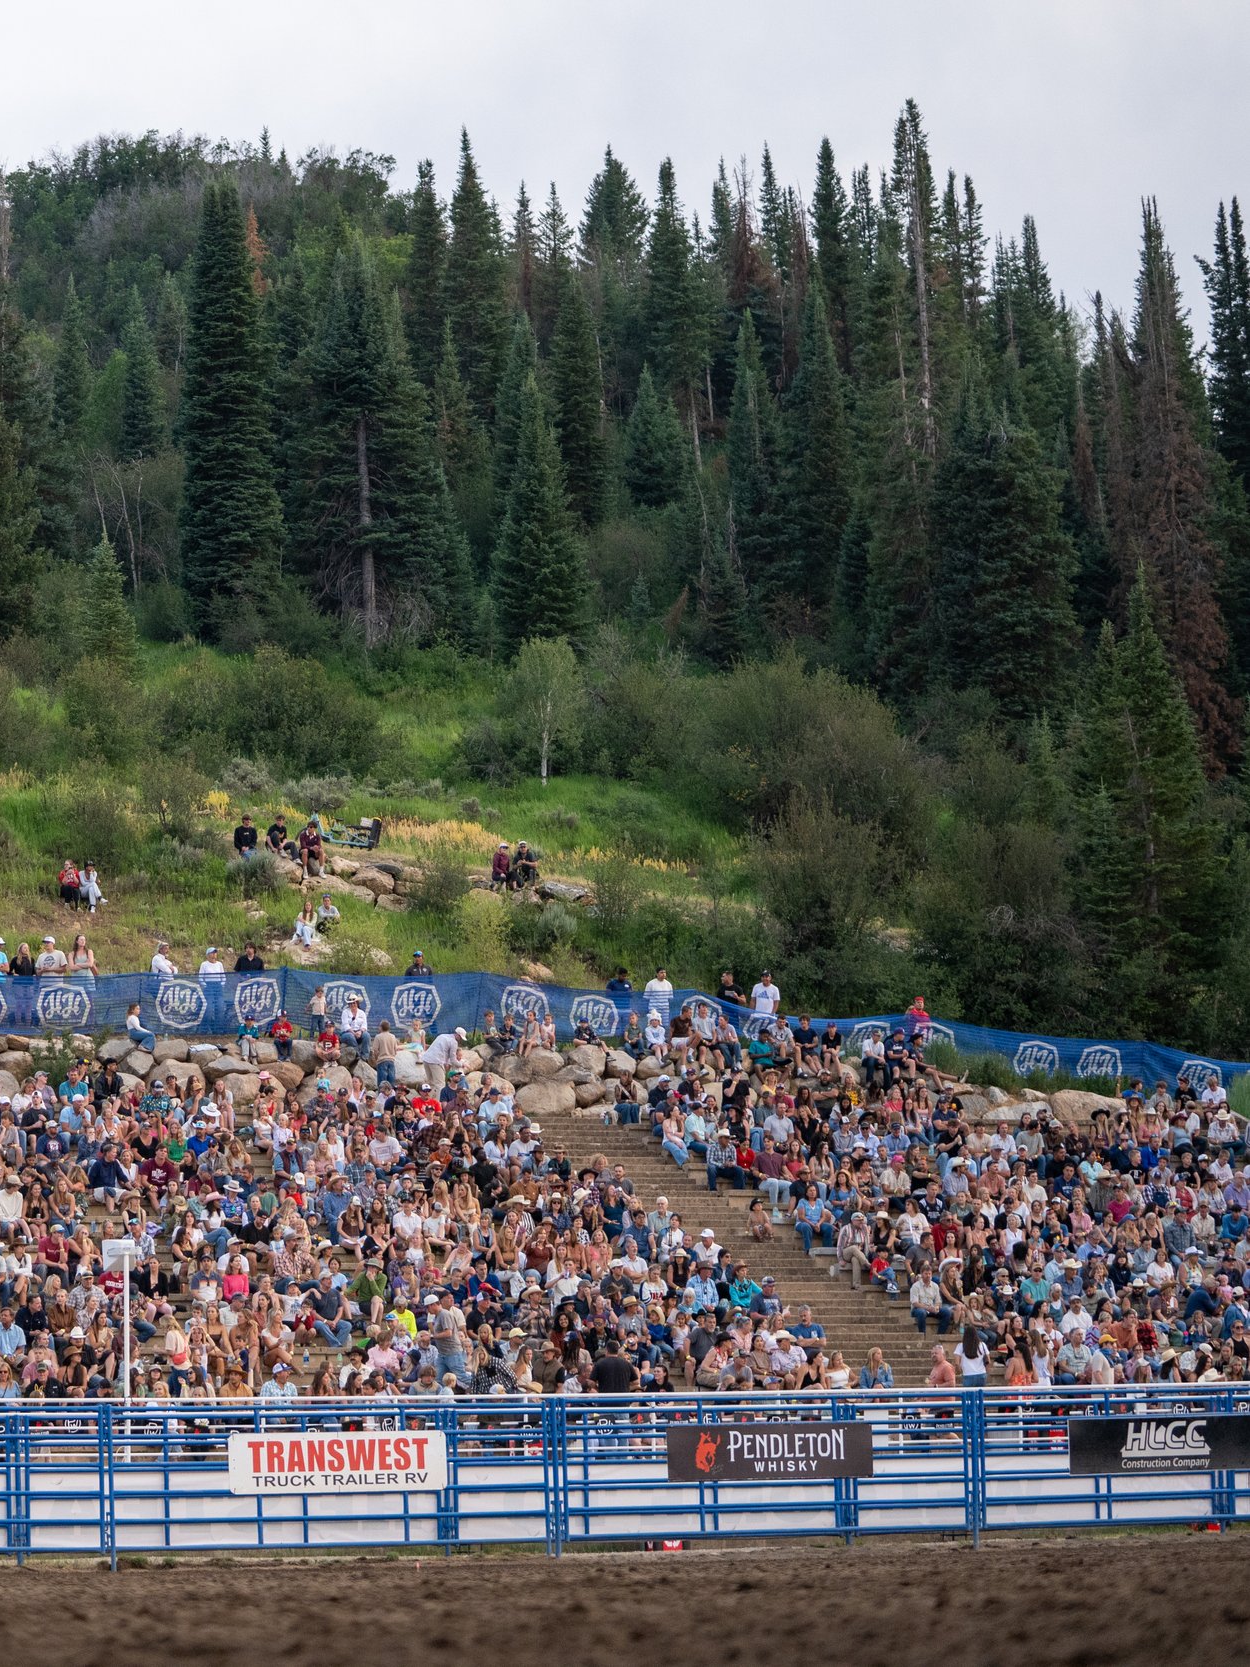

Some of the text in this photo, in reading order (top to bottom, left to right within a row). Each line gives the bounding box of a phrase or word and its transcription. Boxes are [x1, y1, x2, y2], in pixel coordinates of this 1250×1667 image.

[727, 1429, 845, 1462] PENDLETON
[248, 1438, 428, 1473] TRANSWEST
[1121, 1457, 1211, 1469] Construction Company
[754, 1460, 818, 1472] WHISKY
[252, 1472, 428, 1487] TRUCK TRAILER RV
